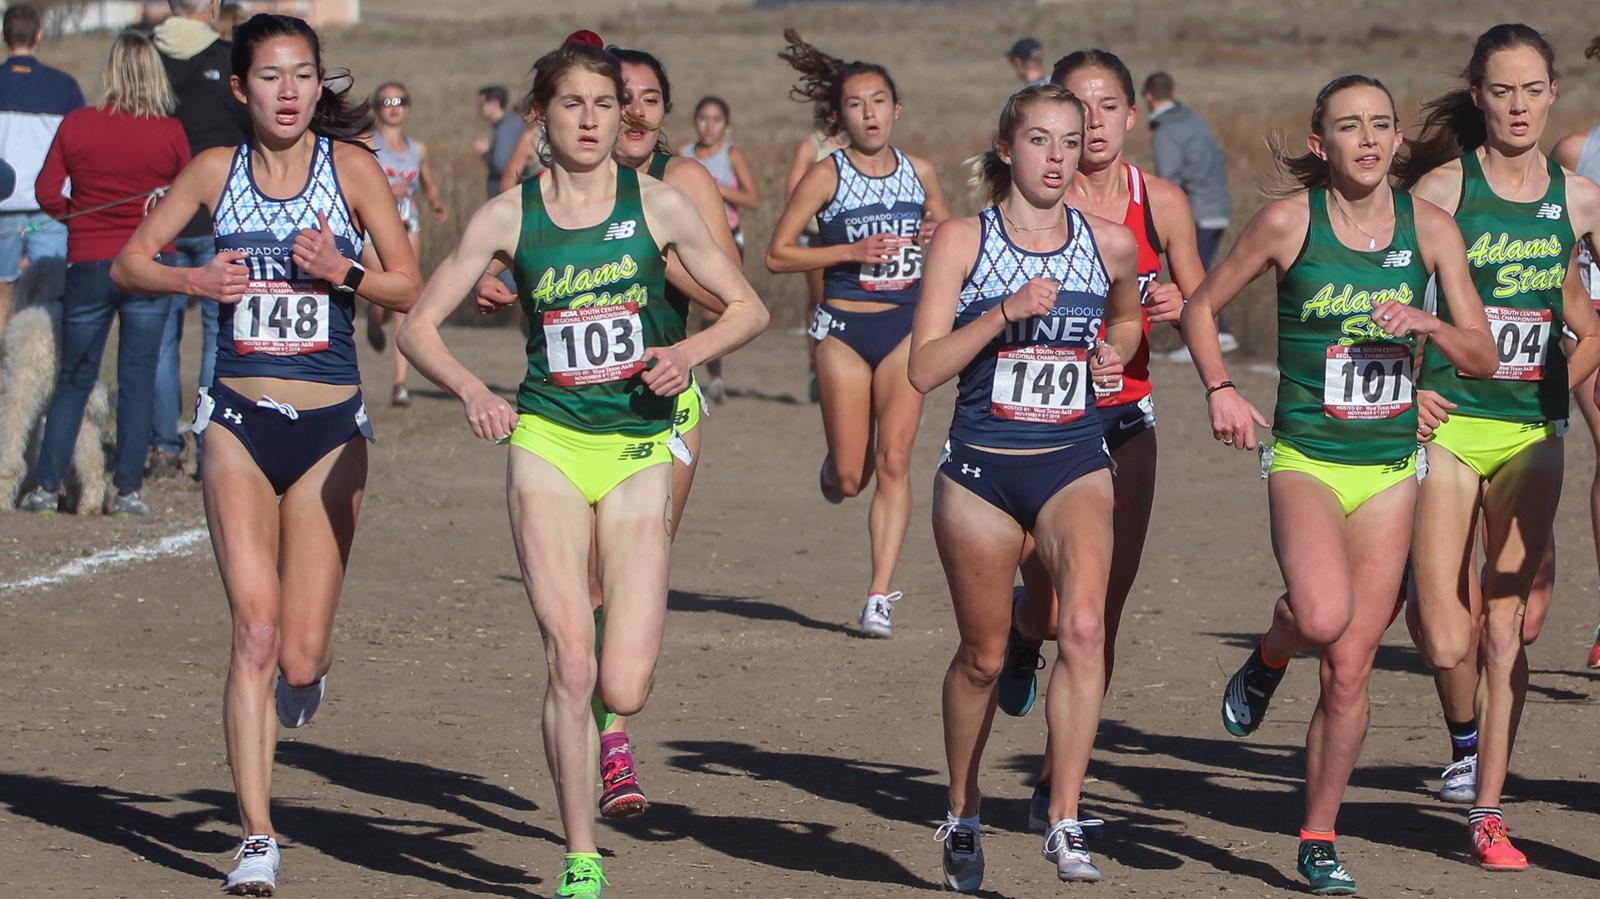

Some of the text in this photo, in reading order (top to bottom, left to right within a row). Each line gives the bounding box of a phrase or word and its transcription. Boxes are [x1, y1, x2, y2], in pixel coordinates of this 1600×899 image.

[1466, 232, 1562, 268] Adams
[531, 254, 639, 304] Adams
[247, 296, 318, 339] 148
[553, 316, 580, 324] REGIONAL
[579, 308, 600, 316] SOUTH
[601, 305, 626, 313] CENTRAL
[1301, 283, 1414, 321] Adams
[560, 319, 635, 368] 103
[1489, 322, 1542, 363] 04
[1011, 361, 1079, 406] 149
[1341, 360, 1403, 403] 101
